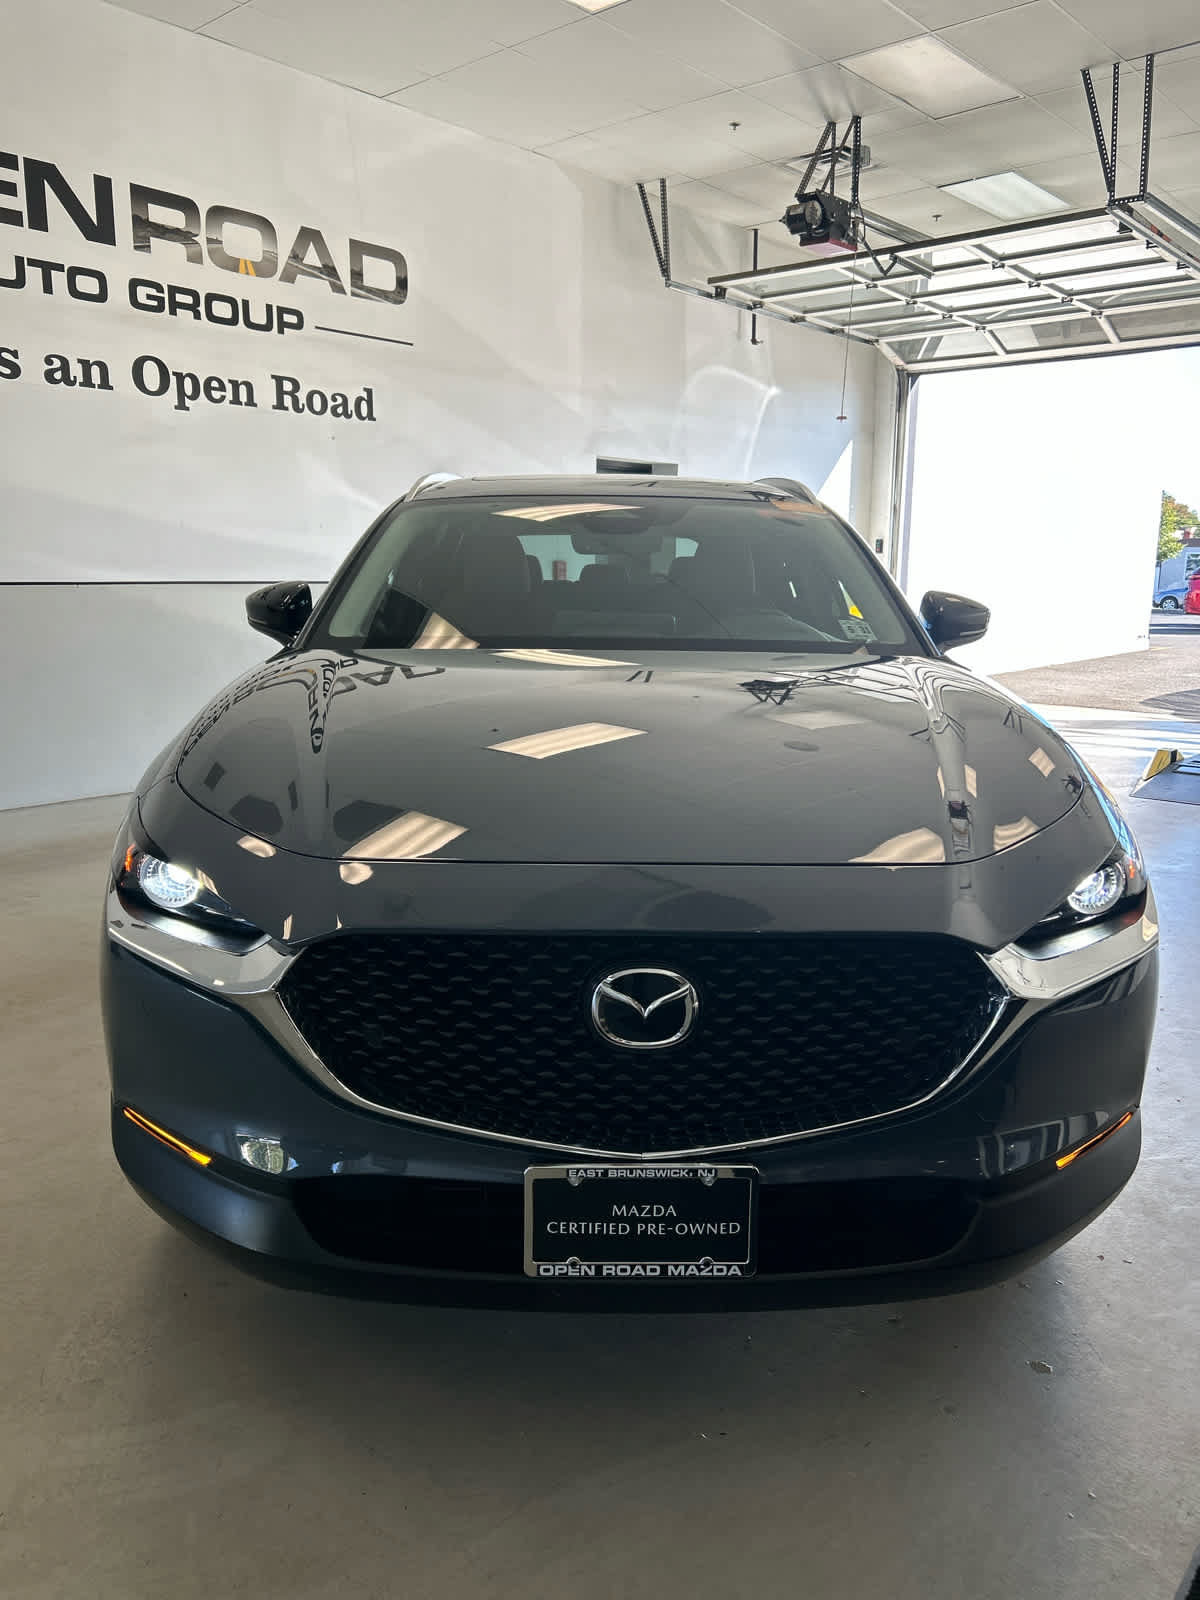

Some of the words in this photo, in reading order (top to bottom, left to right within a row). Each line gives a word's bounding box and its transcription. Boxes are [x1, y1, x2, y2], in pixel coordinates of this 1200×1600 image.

[129, 182, 408, 305] ROAD
[128, 277, 304, 335] GROUP
[43, 353, 113, 391] an
[131, 354, 257, 412] Open
[271, 375, 376, 422] Road
[568, 1169, 603, 1177] EAST
[608, 1168, 693, 1178] BRUNSWICK,
[697, 1169, 715, 1177] NJ
[612, 1204, 677, 1217] MAZDA
[547, 1221, 630, 1235] CERTIFIED
[637, 1222, 740, 1235] PRE-OWNED
[539, 1265, 595, 1276] OPEN
[602, 1265, 661, 1276] ROAD
[667, 1265, 742, 1276] MAZDA
